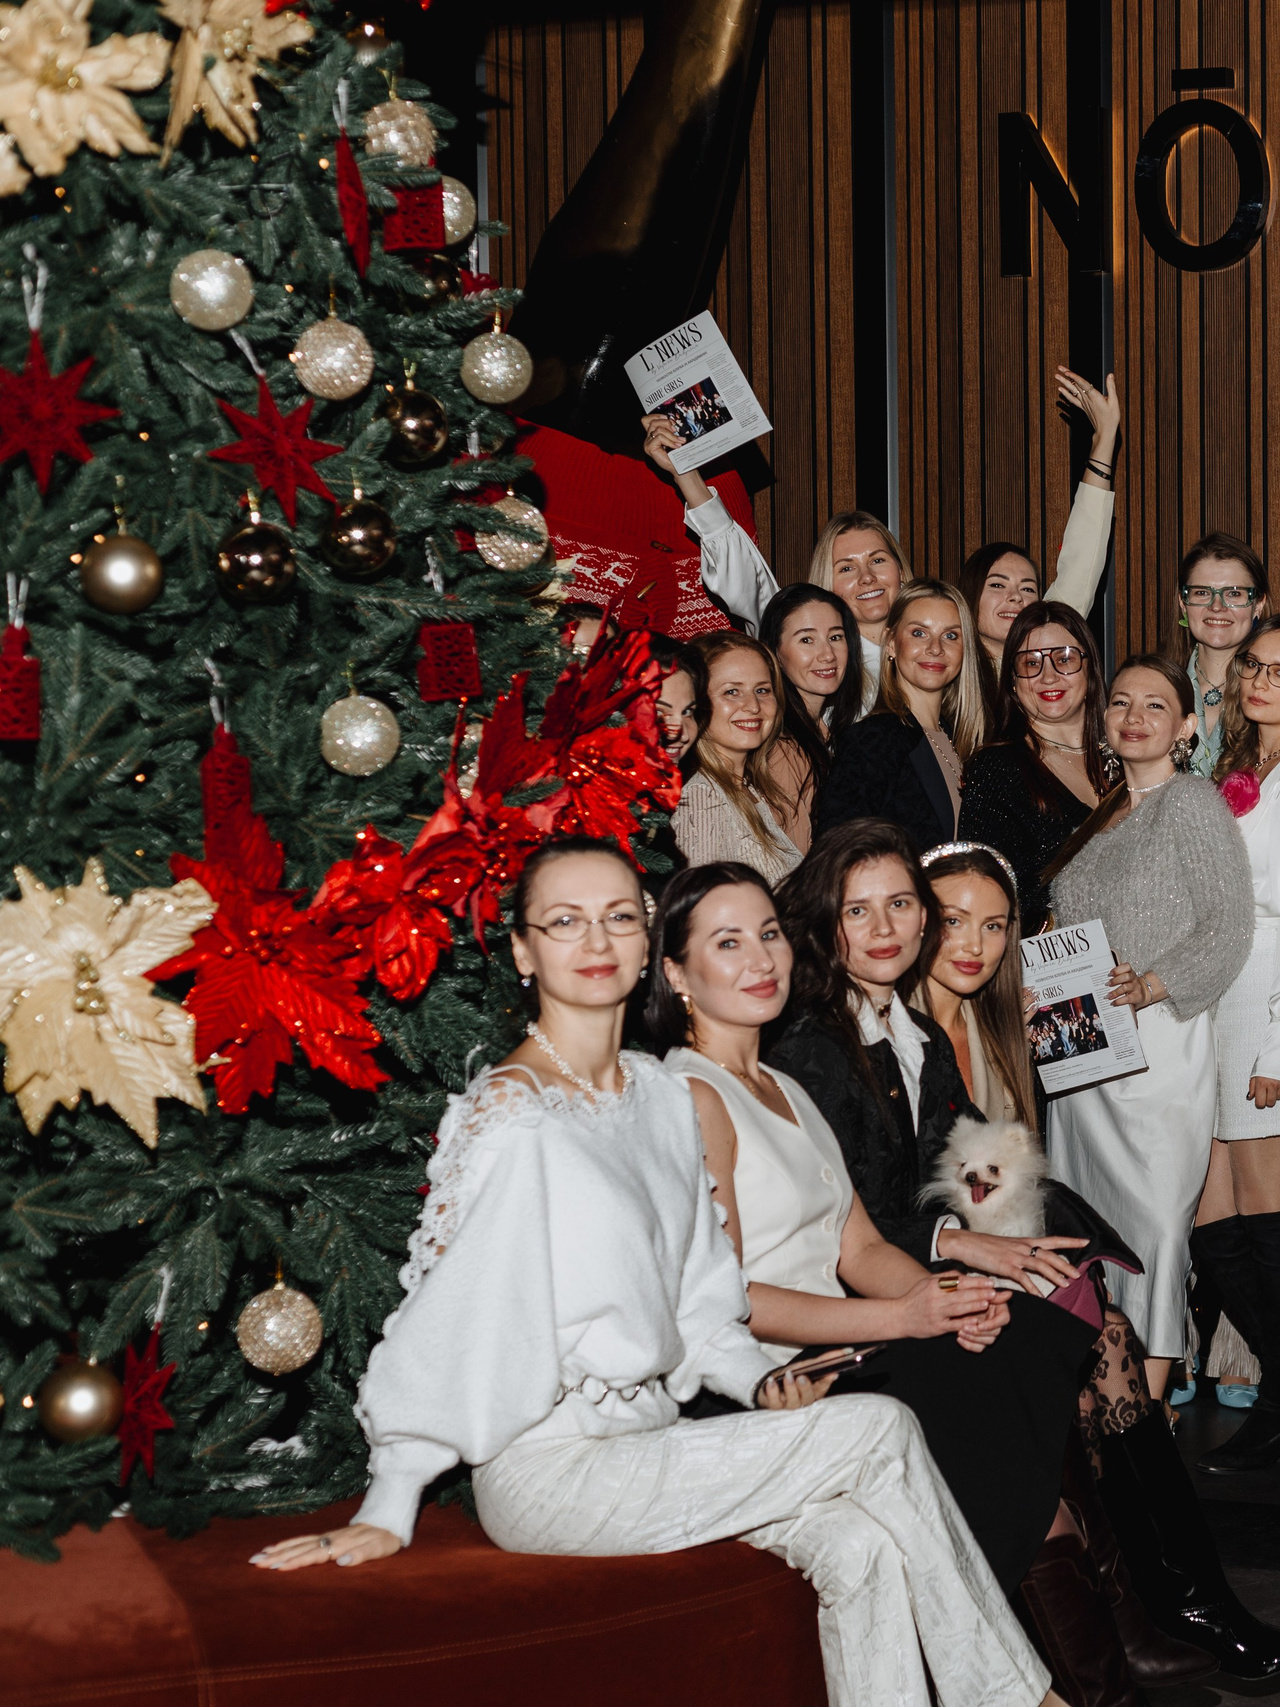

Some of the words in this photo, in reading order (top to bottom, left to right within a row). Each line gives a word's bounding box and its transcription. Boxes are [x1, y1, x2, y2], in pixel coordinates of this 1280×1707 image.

[645, 388, 664, 406] SHINE
[664, 377, 684, 394] GIRLS
[1042, 984, 1064, 1000] GIRLS
